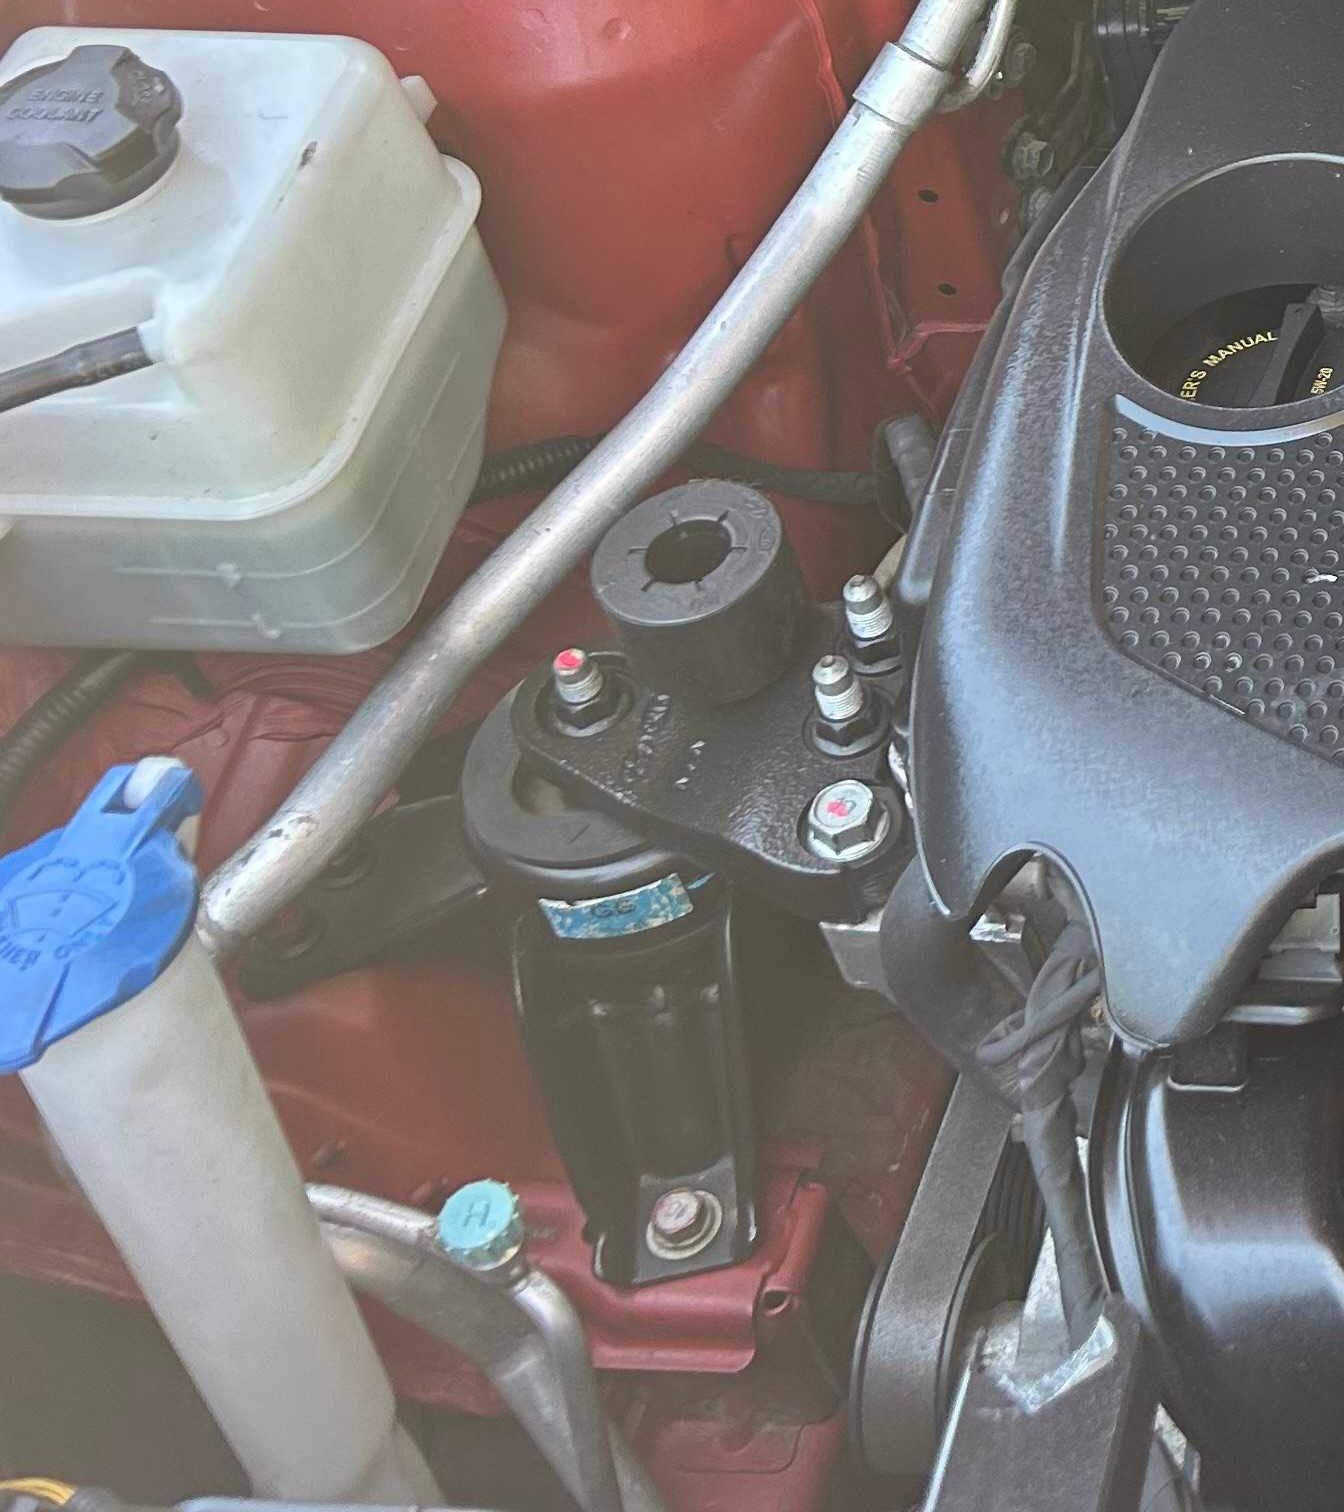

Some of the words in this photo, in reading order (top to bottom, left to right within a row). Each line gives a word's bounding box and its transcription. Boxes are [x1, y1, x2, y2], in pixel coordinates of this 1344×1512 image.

[1179, 370, 1208, 401] ER'S
[1202, 331, 1280, 367] MANUAL
[1310, 366, 1334, 396] 5W-20
